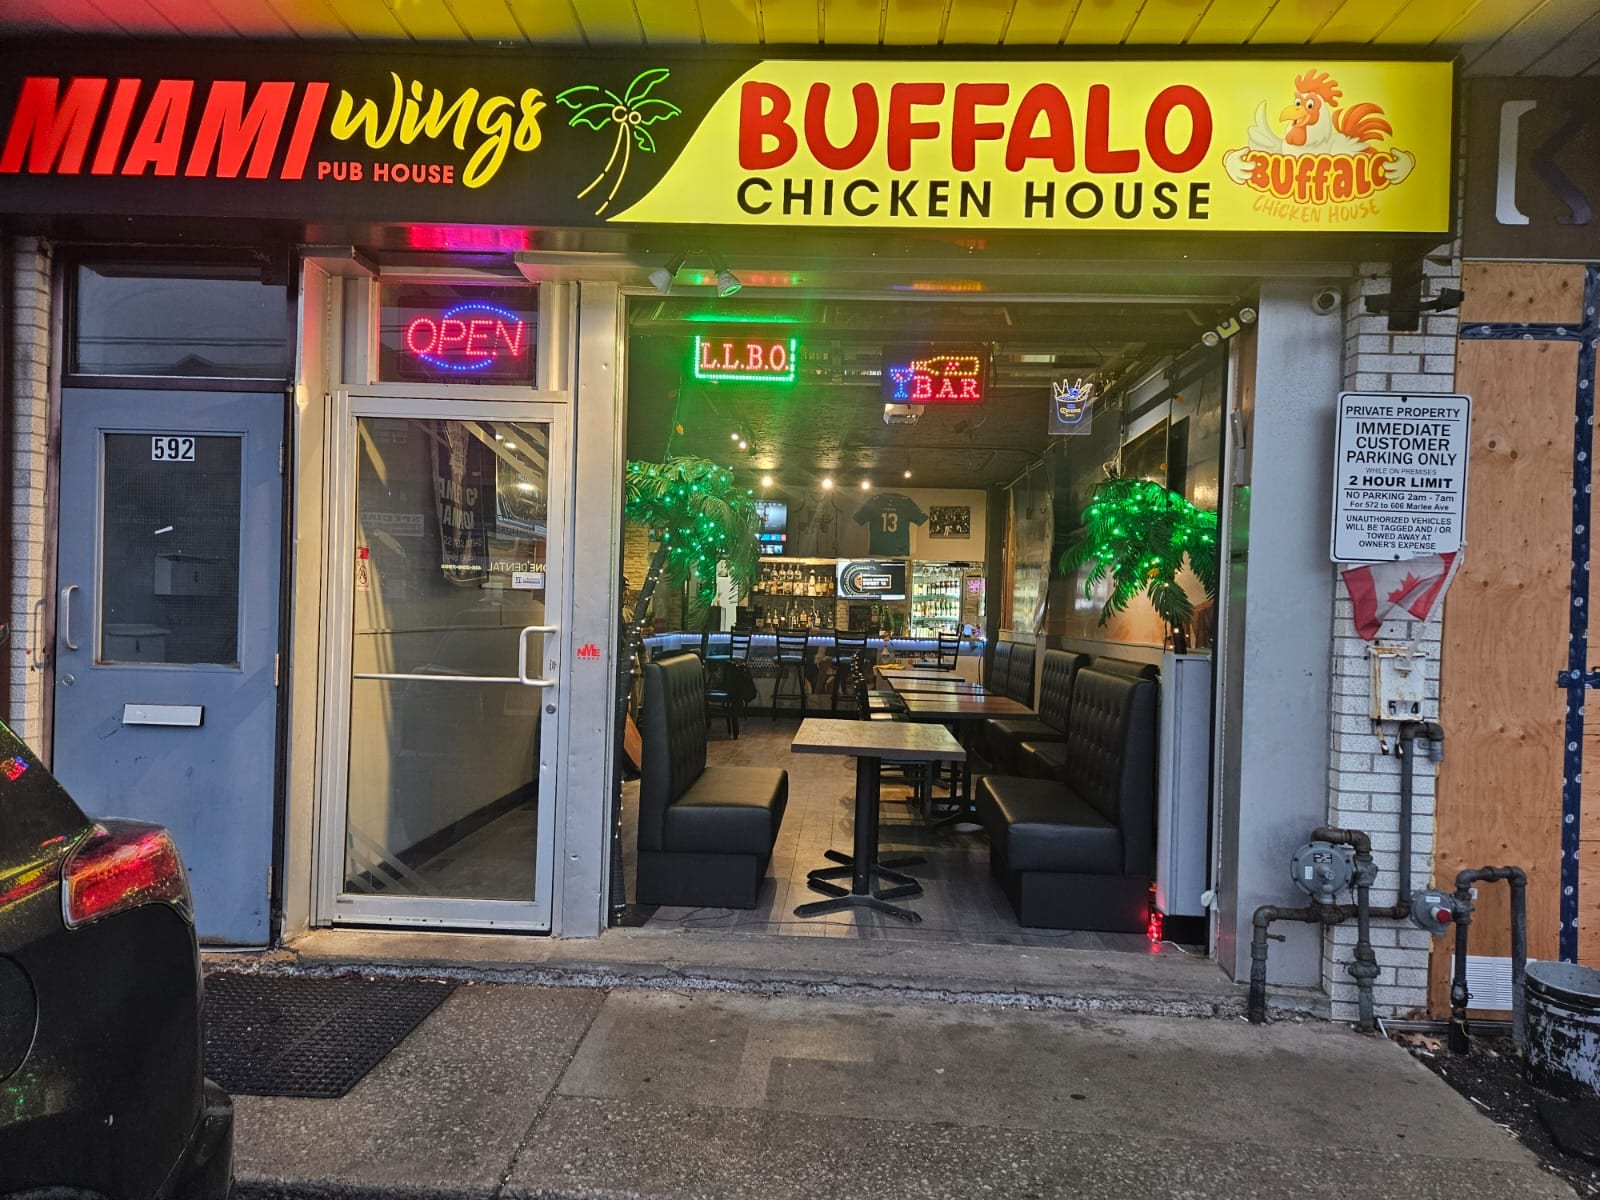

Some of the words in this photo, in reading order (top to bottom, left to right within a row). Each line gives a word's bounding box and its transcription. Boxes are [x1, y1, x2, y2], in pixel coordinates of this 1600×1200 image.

[0, 76, 330, 180] MIAMI
[330, 72, 547, 189] Wings
[738, 81, 1213, 175] BUFFALO
[318, 162, 363, 182] PUB
[373, 162, 455, 184] HOUSE
[737, 177, 991, 218] CHICKEN
[1024, 180, 1211, 220] HOUSE
[1329, 199, 1380, 223] HOUSE
[407, 318, 523, 356] OPEN
[912, 375, 980, 398] BAR
[1345, 405, 1394, 417] PRIVATE
[1396, 407, 1460, 418] PROPERTY
[1355, 422, 1451, 437] IMMEDIATE
[154, 438, 193, 460] 592
[1356, 437, 1450, 451] CUSTOMER
[1346, 451, 1413, 465] PARKING
[1417, 452, 1457, 466] ONLY
[1365, 467, 1387, 475] WHILE
[1349, 475, 1358, 486] 2
[1362, 476, 1406, 487] HOUR
[1411, 477, 1453, 489] LIMIT
[1346, 491, 1360, 499] NO
[1362, 492, 1405, 501] PARKING
[1407, 493, 1427, 501] 2am
[1435, 494, 1454, 502] 7am
[1365, 501, 1379, 509] 572
[1434, 503, 1449, 511] Ave
[881, 512, 898, 532] 13
[1346, 515, 1409, 524] UNAUTHORIZED
[1411, 517, 1452, 525] VEHICLES
[1345, 523, 1365, 531] WILL
[1380, 524, 1413, 533] TAGGED
[1415, 525, 1433, 533] AND
[1439, 526, 1452, 534] OR
[1366, 532, 1395, 540] TOWED
[1397, 533, 1420, 541] AWAY
[1358, 540, 1396, 549] OWNER'S
[1398, 541, 1437, 550] EXPENSE
